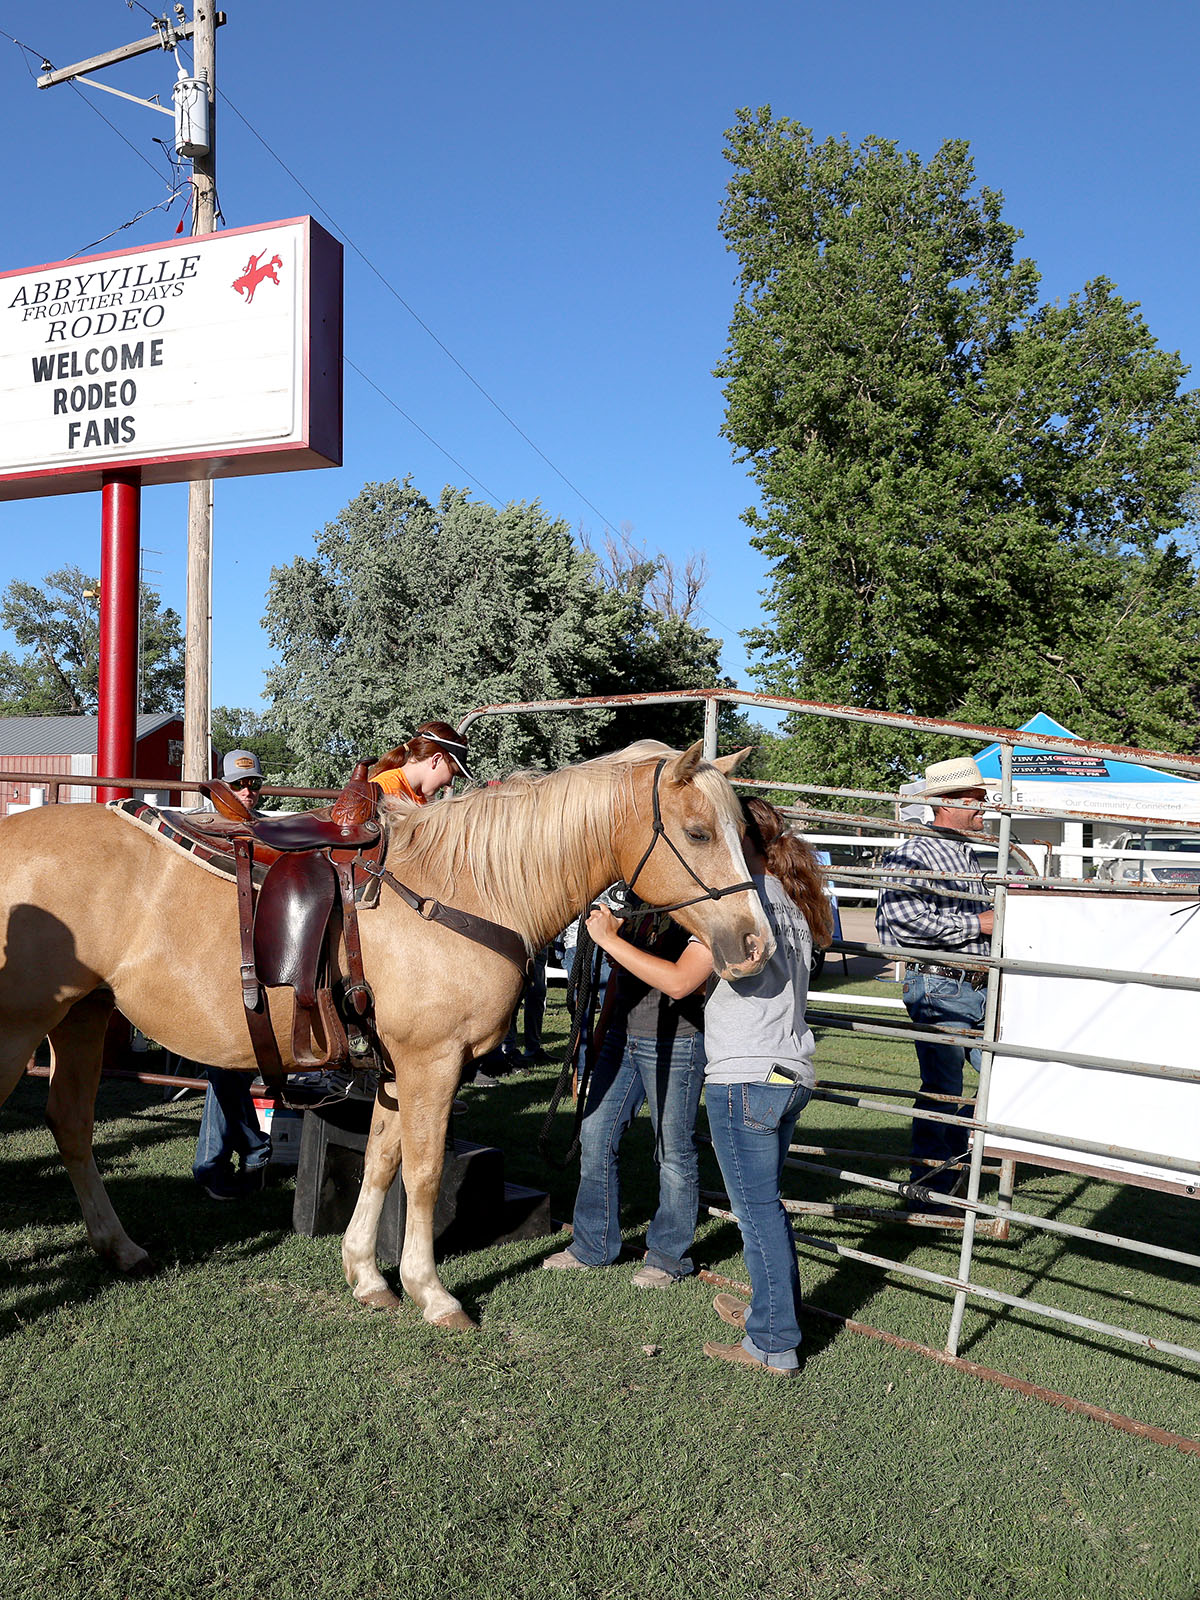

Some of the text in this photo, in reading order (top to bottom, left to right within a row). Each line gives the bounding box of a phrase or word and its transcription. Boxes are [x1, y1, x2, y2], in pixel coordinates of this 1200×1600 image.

[8, 255, 201, 309] ABBYVILLE
[22, 282, 185, 322] FRONTIER DAYS
[45, 304, 165, 344] RODEO
[31, 338, 164, 383] WELCOME
[53, 378, 137, 415] RODEO
[68, 415, 136, 450] FANS
